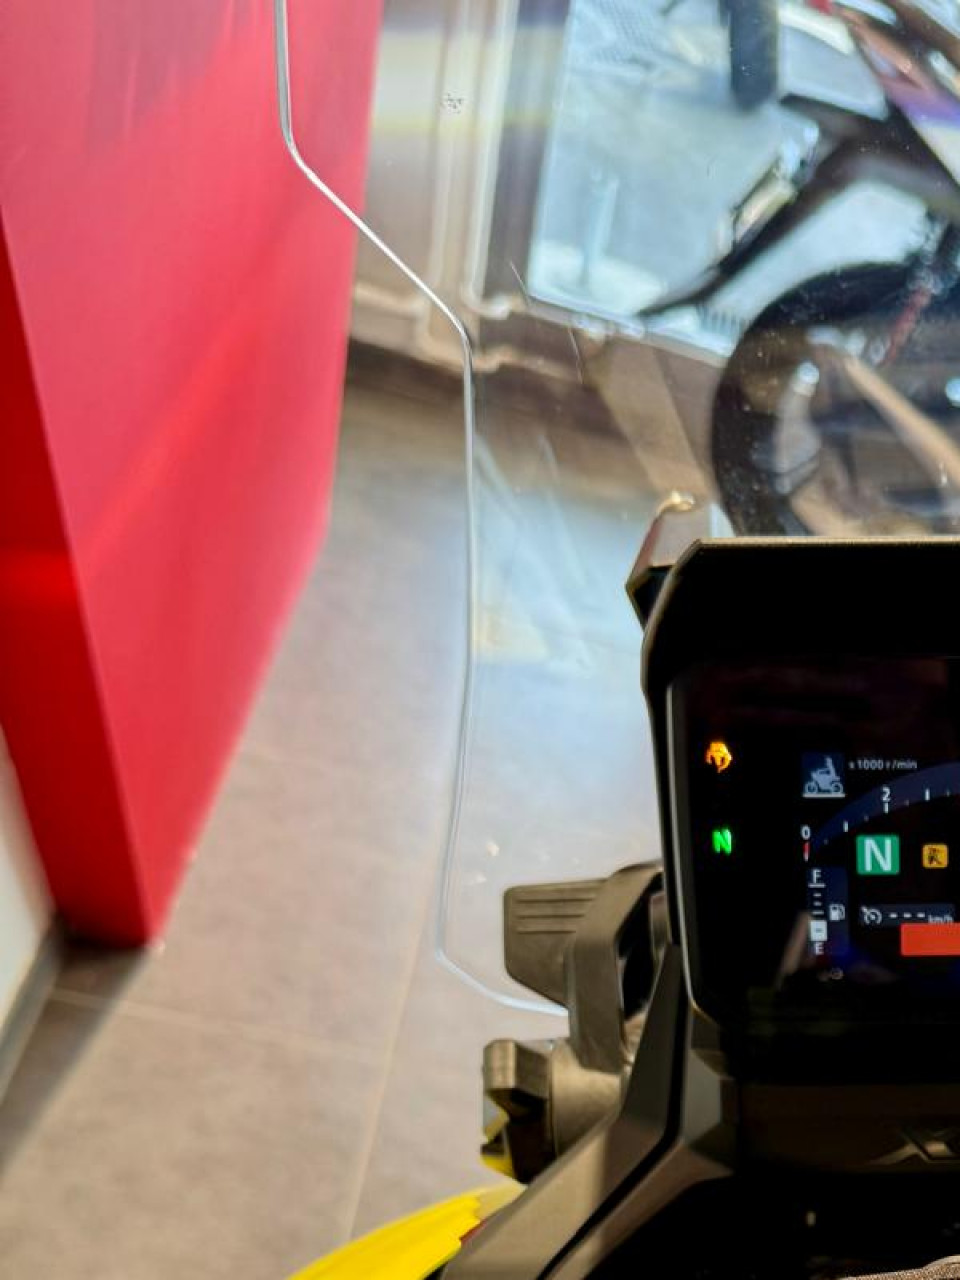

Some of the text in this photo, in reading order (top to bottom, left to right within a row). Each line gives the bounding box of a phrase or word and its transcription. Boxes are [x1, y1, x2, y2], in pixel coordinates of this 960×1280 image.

[881, 787, 891, 802] 2
[800, 825, 811, 839] 0
[711, 828, 732, 855] N
[863, 838, 892, 872] N
[812, 869, 822, 884] F
